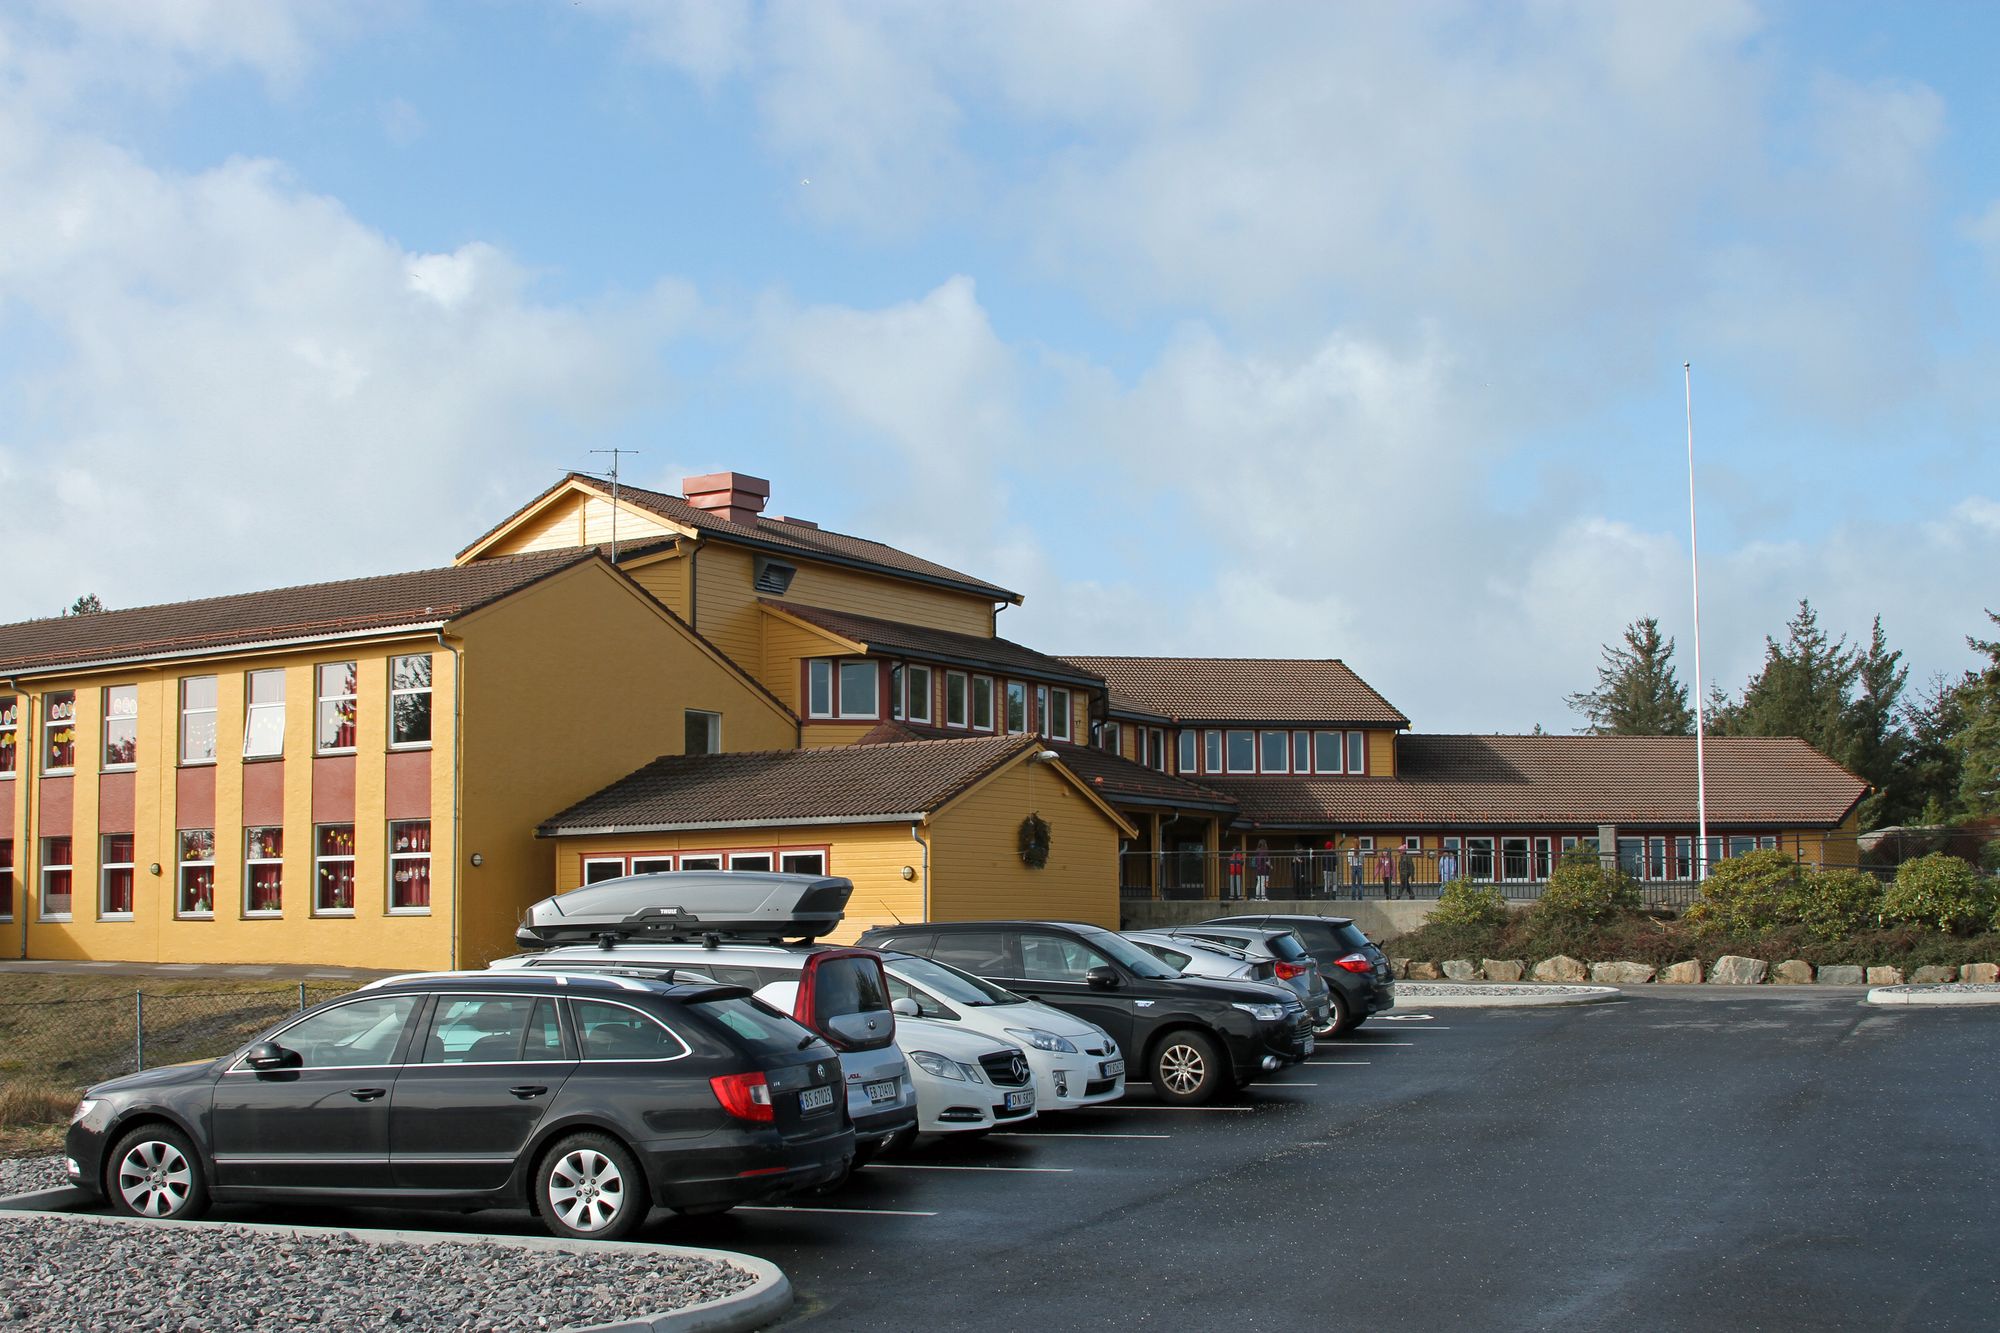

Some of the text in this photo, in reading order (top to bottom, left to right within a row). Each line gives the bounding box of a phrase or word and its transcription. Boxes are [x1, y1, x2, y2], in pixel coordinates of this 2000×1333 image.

[804, 1088, 831, 1108] BS 67025
[869, 1086, 878, 1099] EB
[1012, 1094, 1022, 1105] DN
